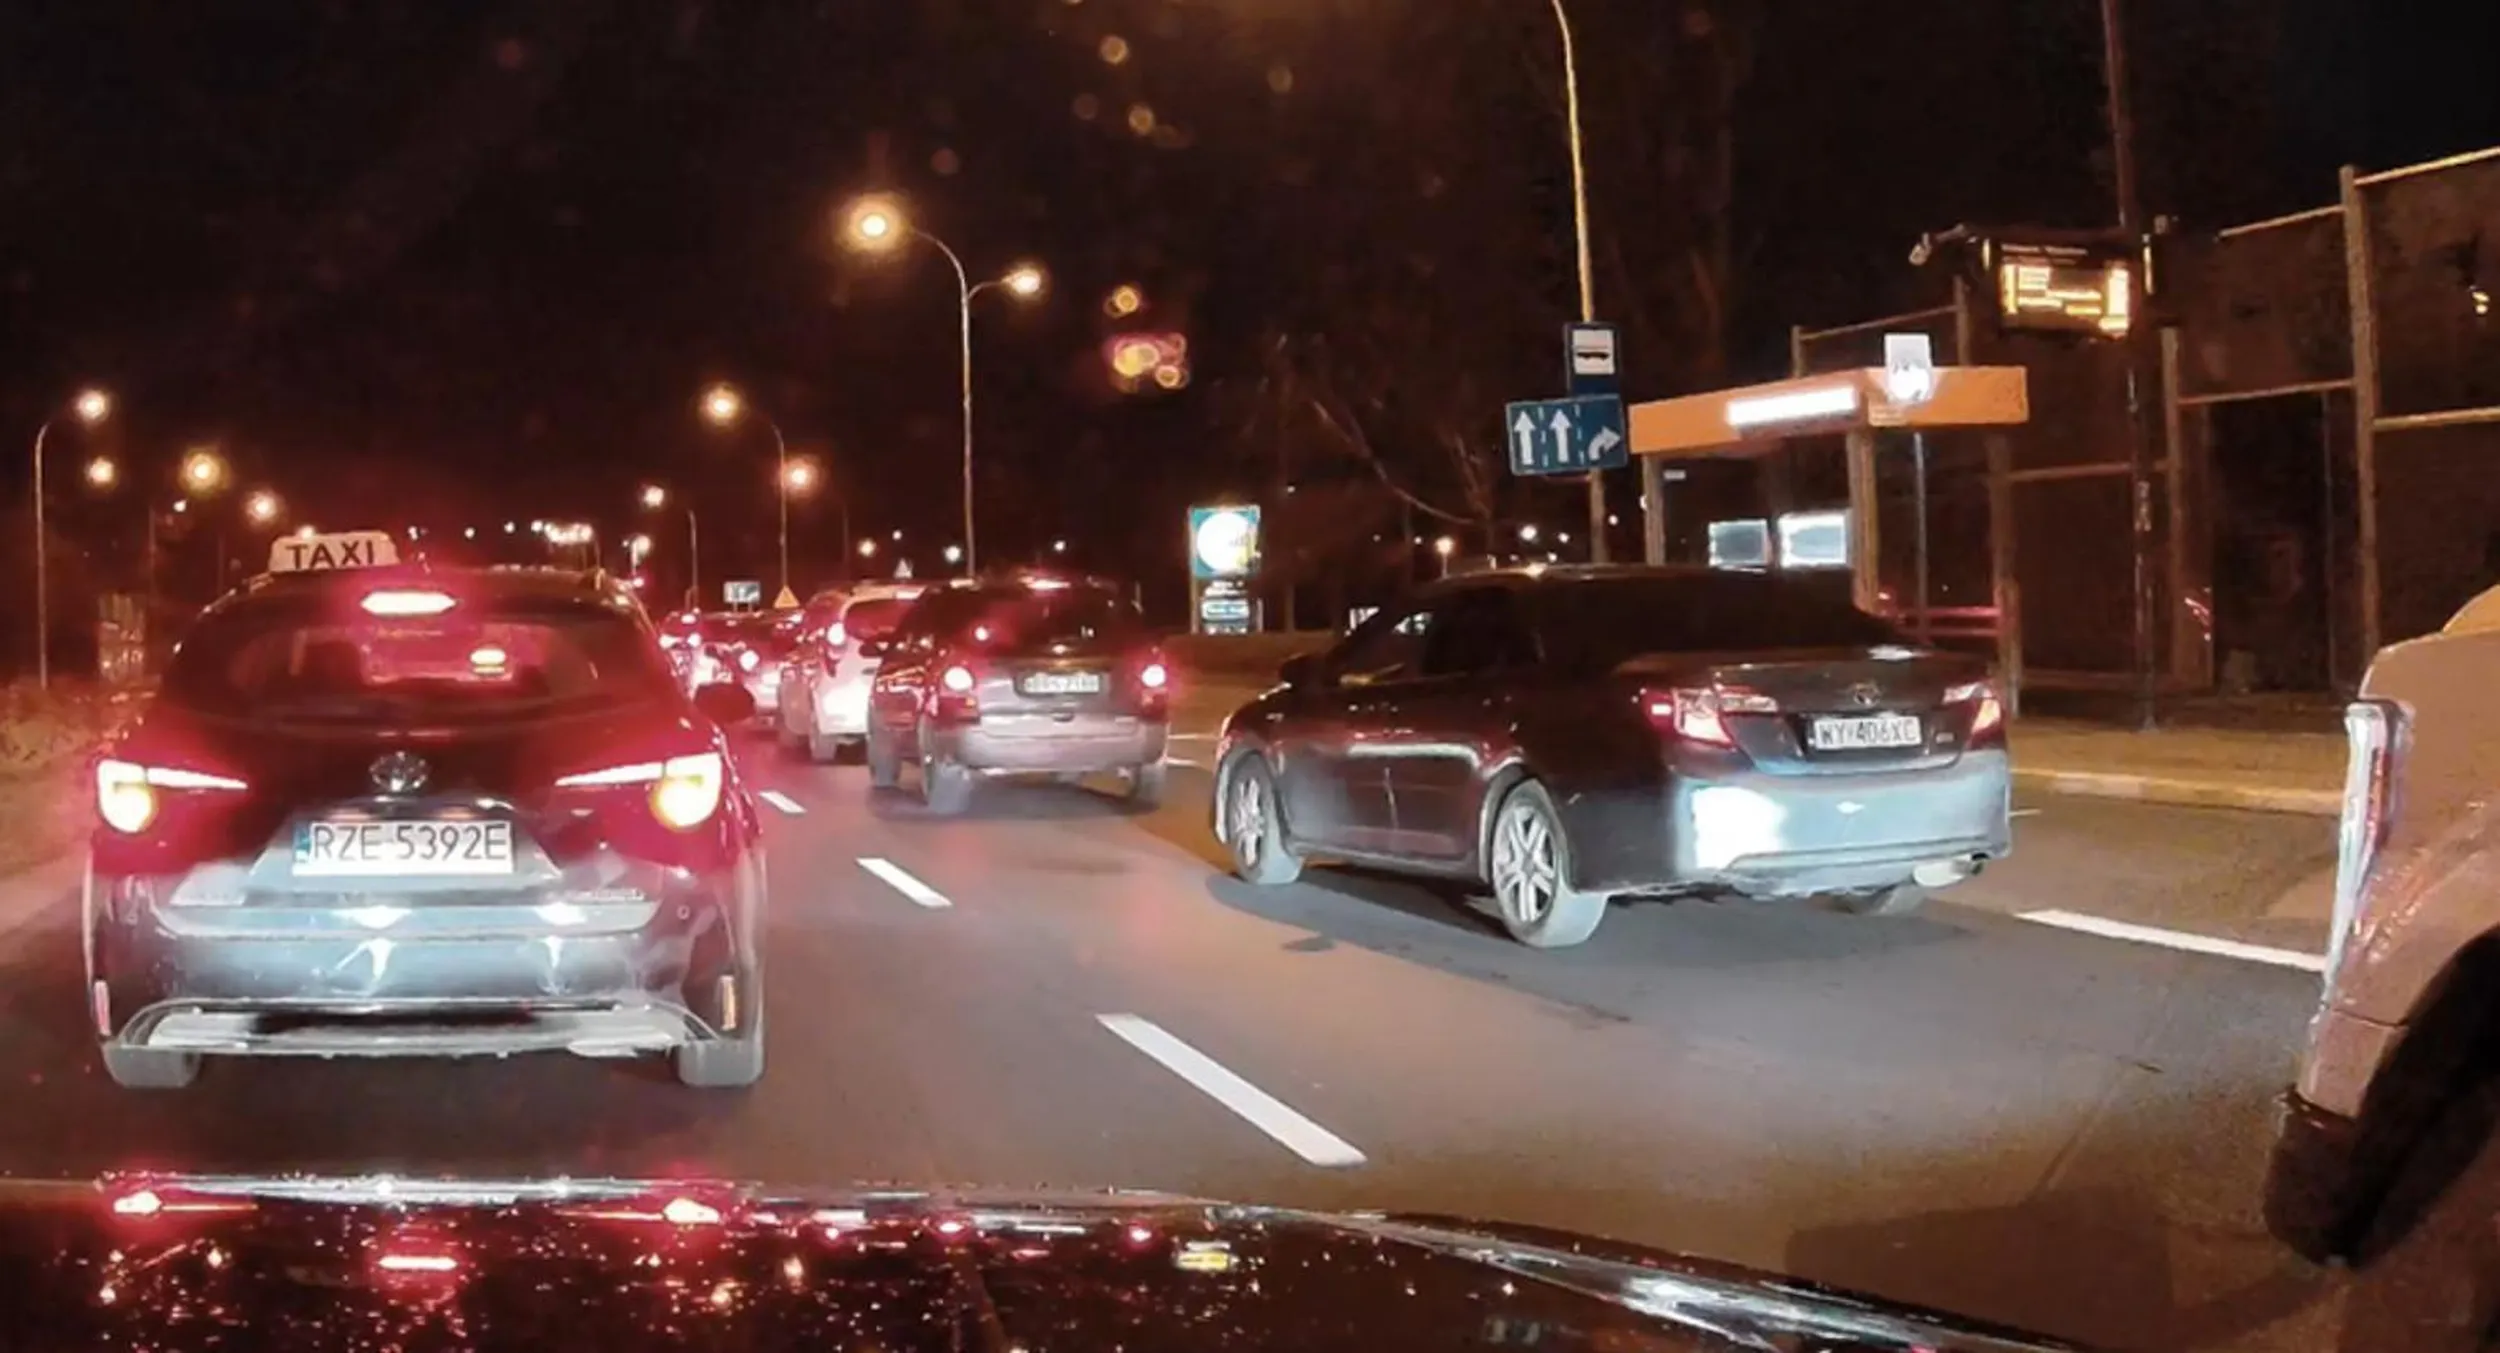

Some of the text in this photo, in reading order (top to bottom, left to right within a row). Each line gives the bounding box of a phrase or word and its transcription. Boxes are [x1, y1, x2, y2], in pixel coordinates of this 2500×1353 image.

[285, 540, 375, 570] TAXI
[313, 823, 507, 861] RZE 5392E
